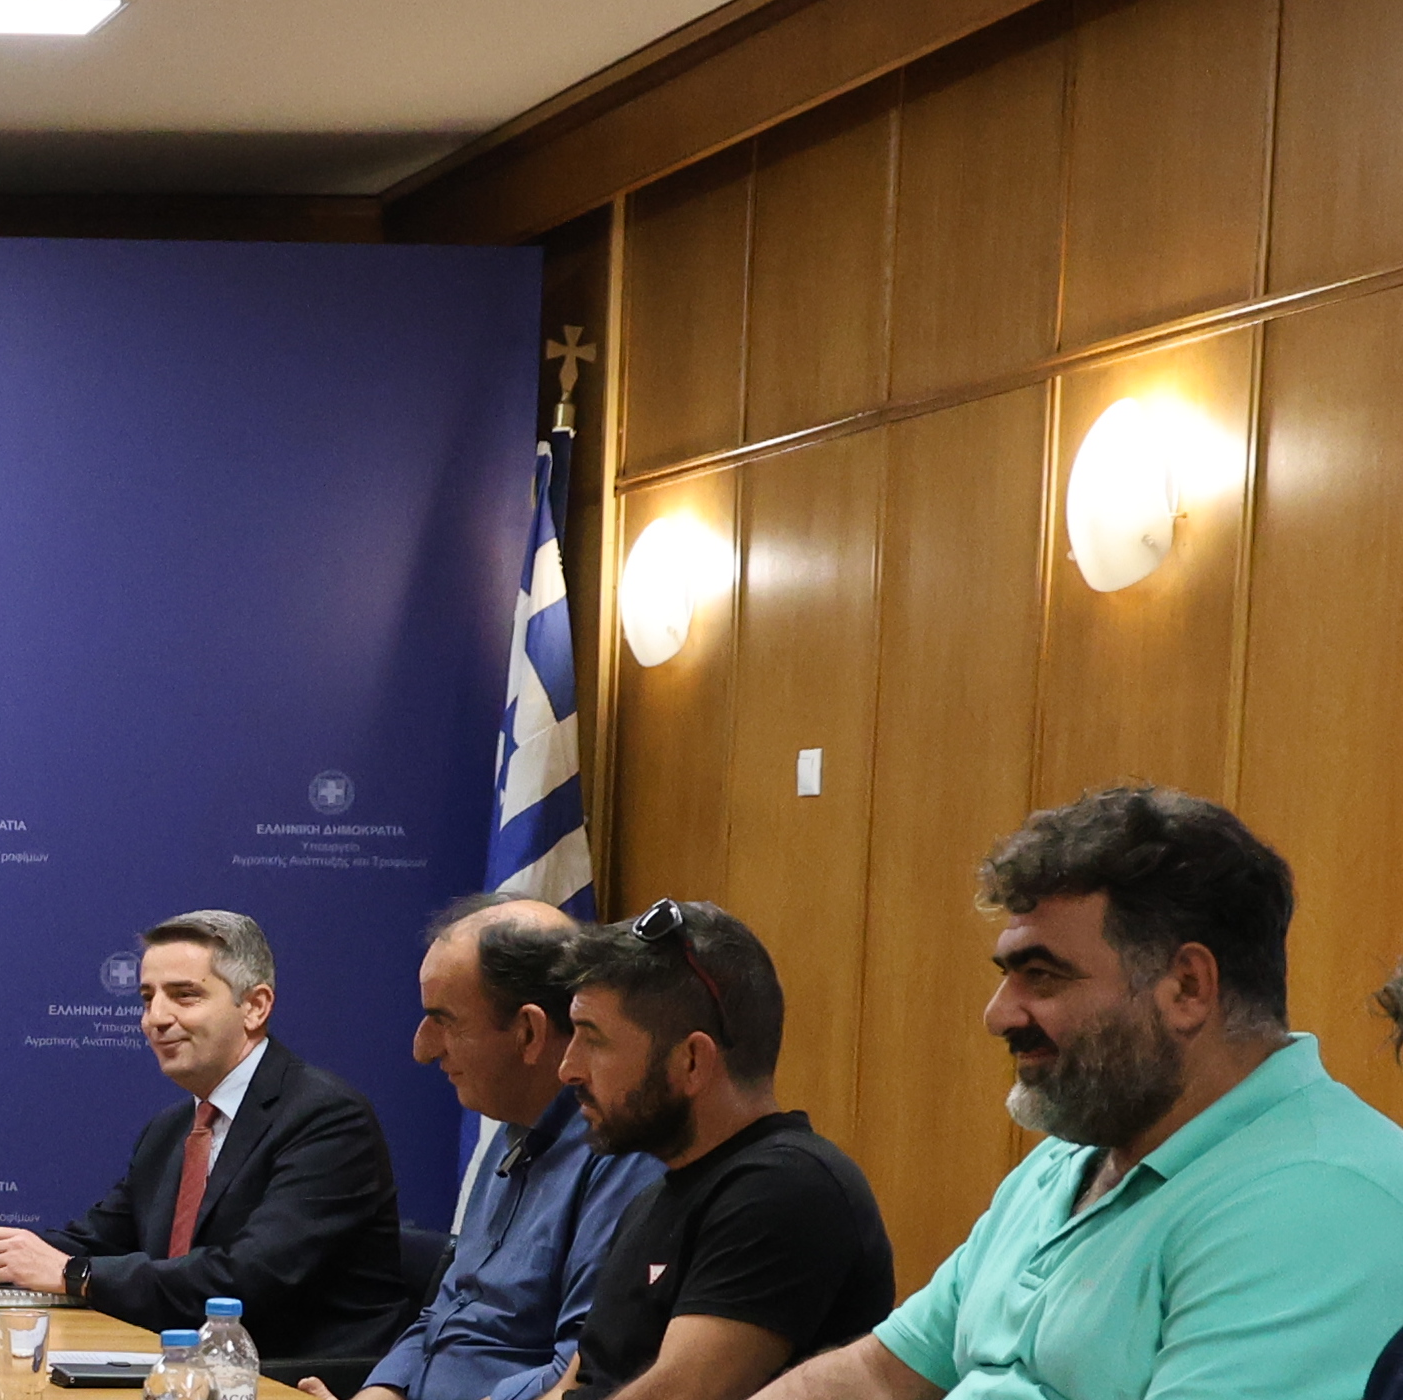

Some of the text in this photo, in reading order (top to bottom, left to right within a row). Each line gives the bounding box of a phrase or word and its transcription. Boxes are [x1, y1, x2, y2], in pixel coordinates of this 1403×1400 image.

[256, 823, 406, 836] ΕΛΛΗΝΙΚΗ ΔΗΜΟΚΡΑΤΙΑ
[48, 1004, 112, 1016] ΕΛΛΗΝΙΚΗ
